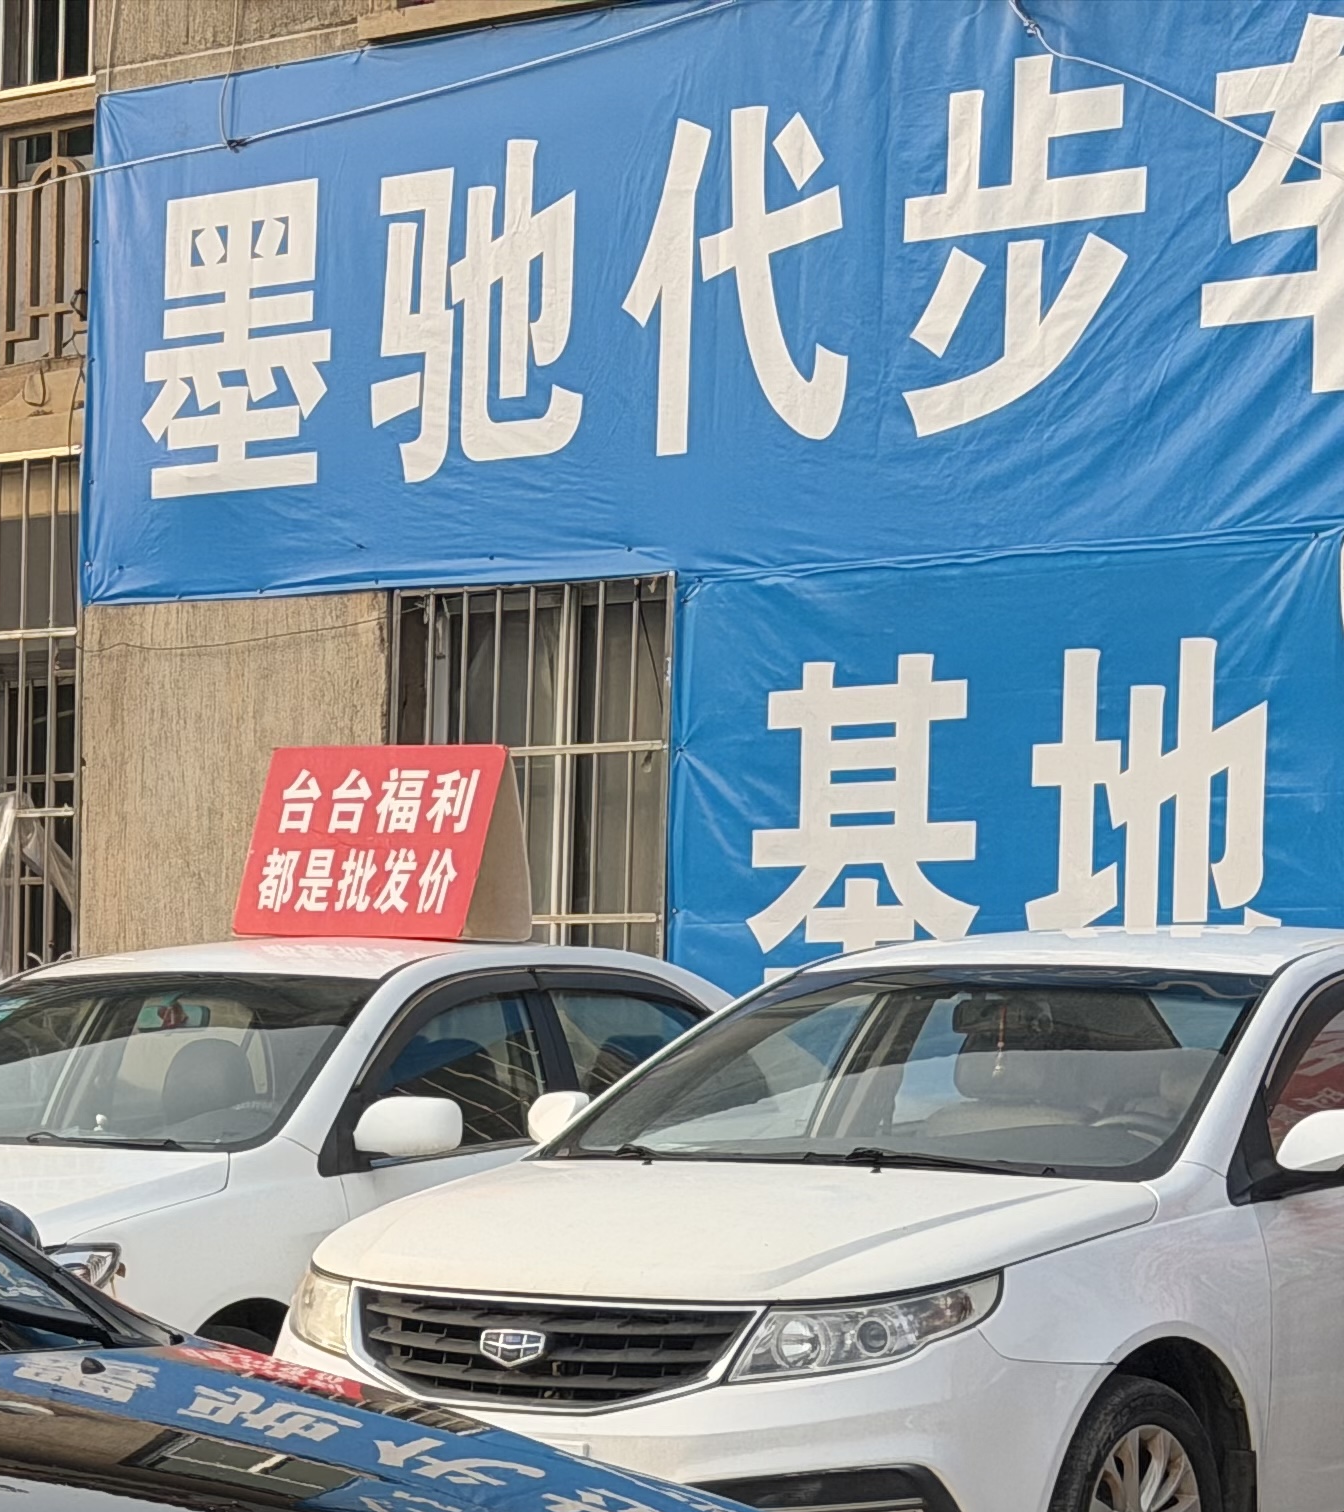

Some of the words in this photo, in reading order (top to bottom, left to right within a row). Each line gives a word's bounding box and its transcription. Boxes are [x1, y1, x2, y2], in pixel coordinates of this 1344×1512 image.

[278, 767, 481, 833] 台台福利
[746, 637, 1281, 985] 基地
[257, 847, 458, 915] 都是批发价
